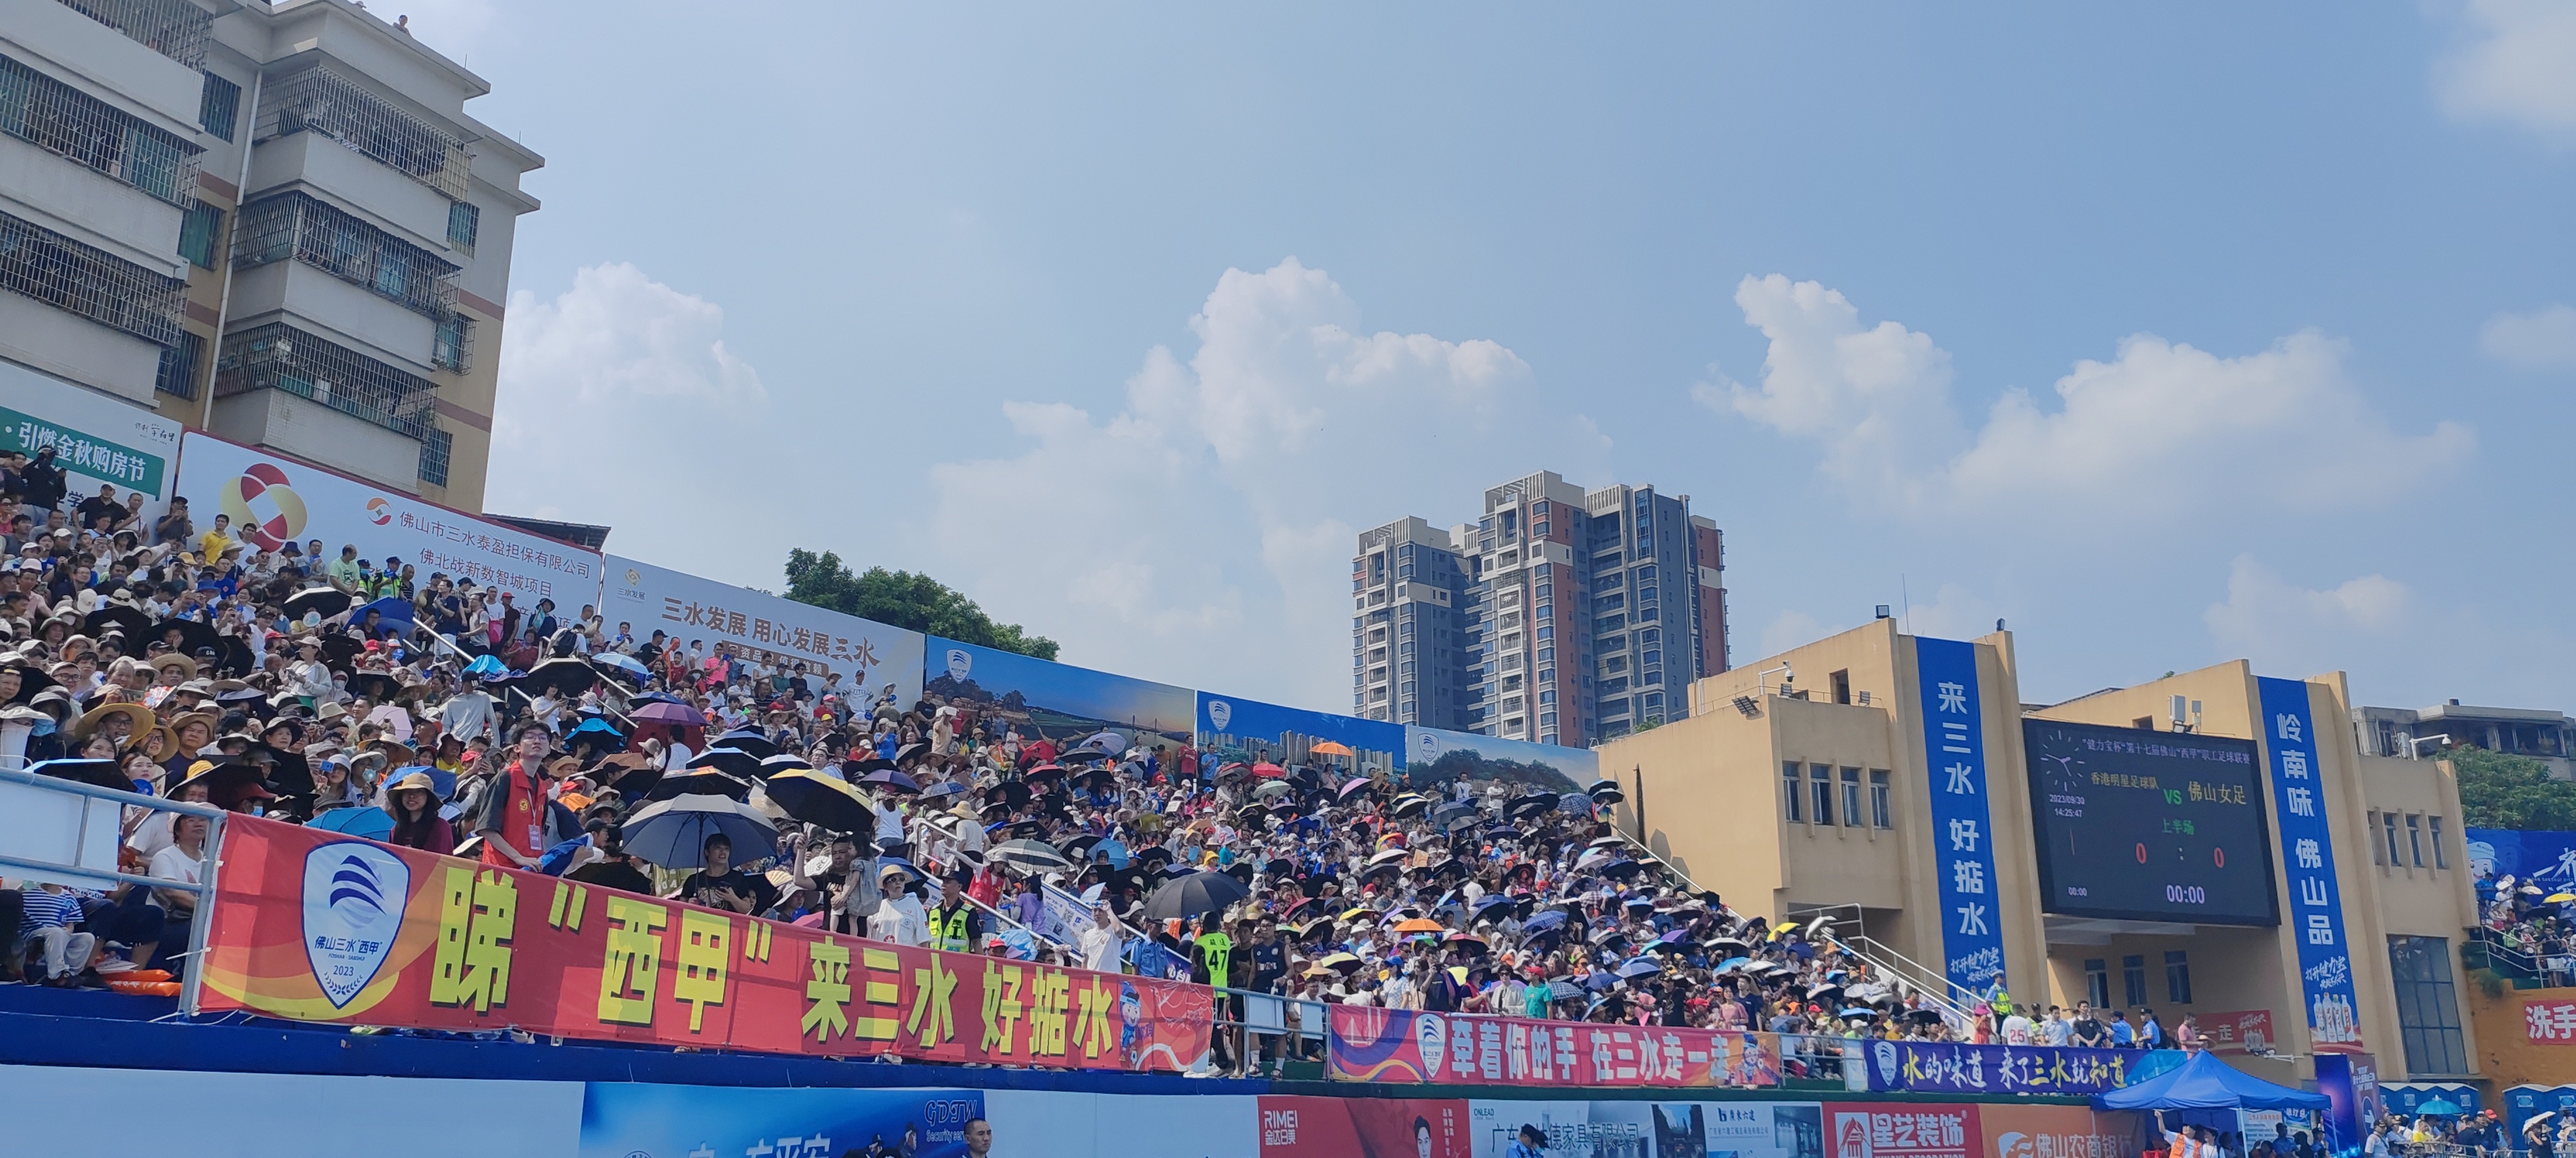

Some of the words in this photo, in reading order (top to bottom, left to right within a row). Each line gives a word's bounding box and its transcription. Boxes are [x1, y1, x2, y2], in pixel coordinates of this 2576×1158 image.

[400, 511, 590, 579] 佛山市三水泰盈担保有限公司
[419, 547, 552, 598] 佛北战新数智城项目
[662, 597, 747, 638] 三水发展
[751, 616, 881, 669] 用心发展三水
[1938, 681, 1975, 795] 来三水
[2276, 712, 2315, 818] 岭南味
[2091, 771, 2159, 790] 香港明星足球队
[2188, 780, 2248, 805] 佛山女足
[2049, 794, 2085, 805] 2023/09/30
[2163, 789, 2183, 806] VS
[2054, 808, 2083, 818] 14:25:47
[2161, 818, 2195, 835] 上半场
[2135, 842, 2147, 865] 0
[2214, 847, 2224, 868] 0
[1949, 818, 1989, 936] 好掂水
[2068, 887, 2087, 897] 00:00
[2166, 884, 2205, 905] 00:00
[2295, 837, 2334, 946] 佛山品
[333, 965, 354, 977] 2023
[1208, 949, 1227, 971] 47
[1950, 946, 2000, 974] 打开健力宝
[2305, 955, 2347, 981] 打开健力宝
[801, 936, 958, 1050] 来三水
[980, 960, 1114, 1059] 好掂水
[2525, 1004, 2576, 1039] 洗手
[2010, 1029, 2025, 1042] 25
[1450, 1020, 1578, 1080] 牵着你的手
[1590, 1028, 1731, 1082] 在三水走一走
[1902, 1046, 1988, 1090] 水的味道
[1998, 1046, 2128, 1090] 来了三水就知道
[1264, 1109, 1299, 1130] RIMEI
[1473, 1108, 1495, 1116] ONLEAD
[926, 1128, 953, 1144] Security
[1265, 1128, 1296, 1146] 金达日美
[1491, 1122, 1640, 1154] 广东德家具有限公司
[1872, 1113, 1964, 1147] 星艺装饰
[2035, 1133, 2133, 1158] 佛山农商银行
